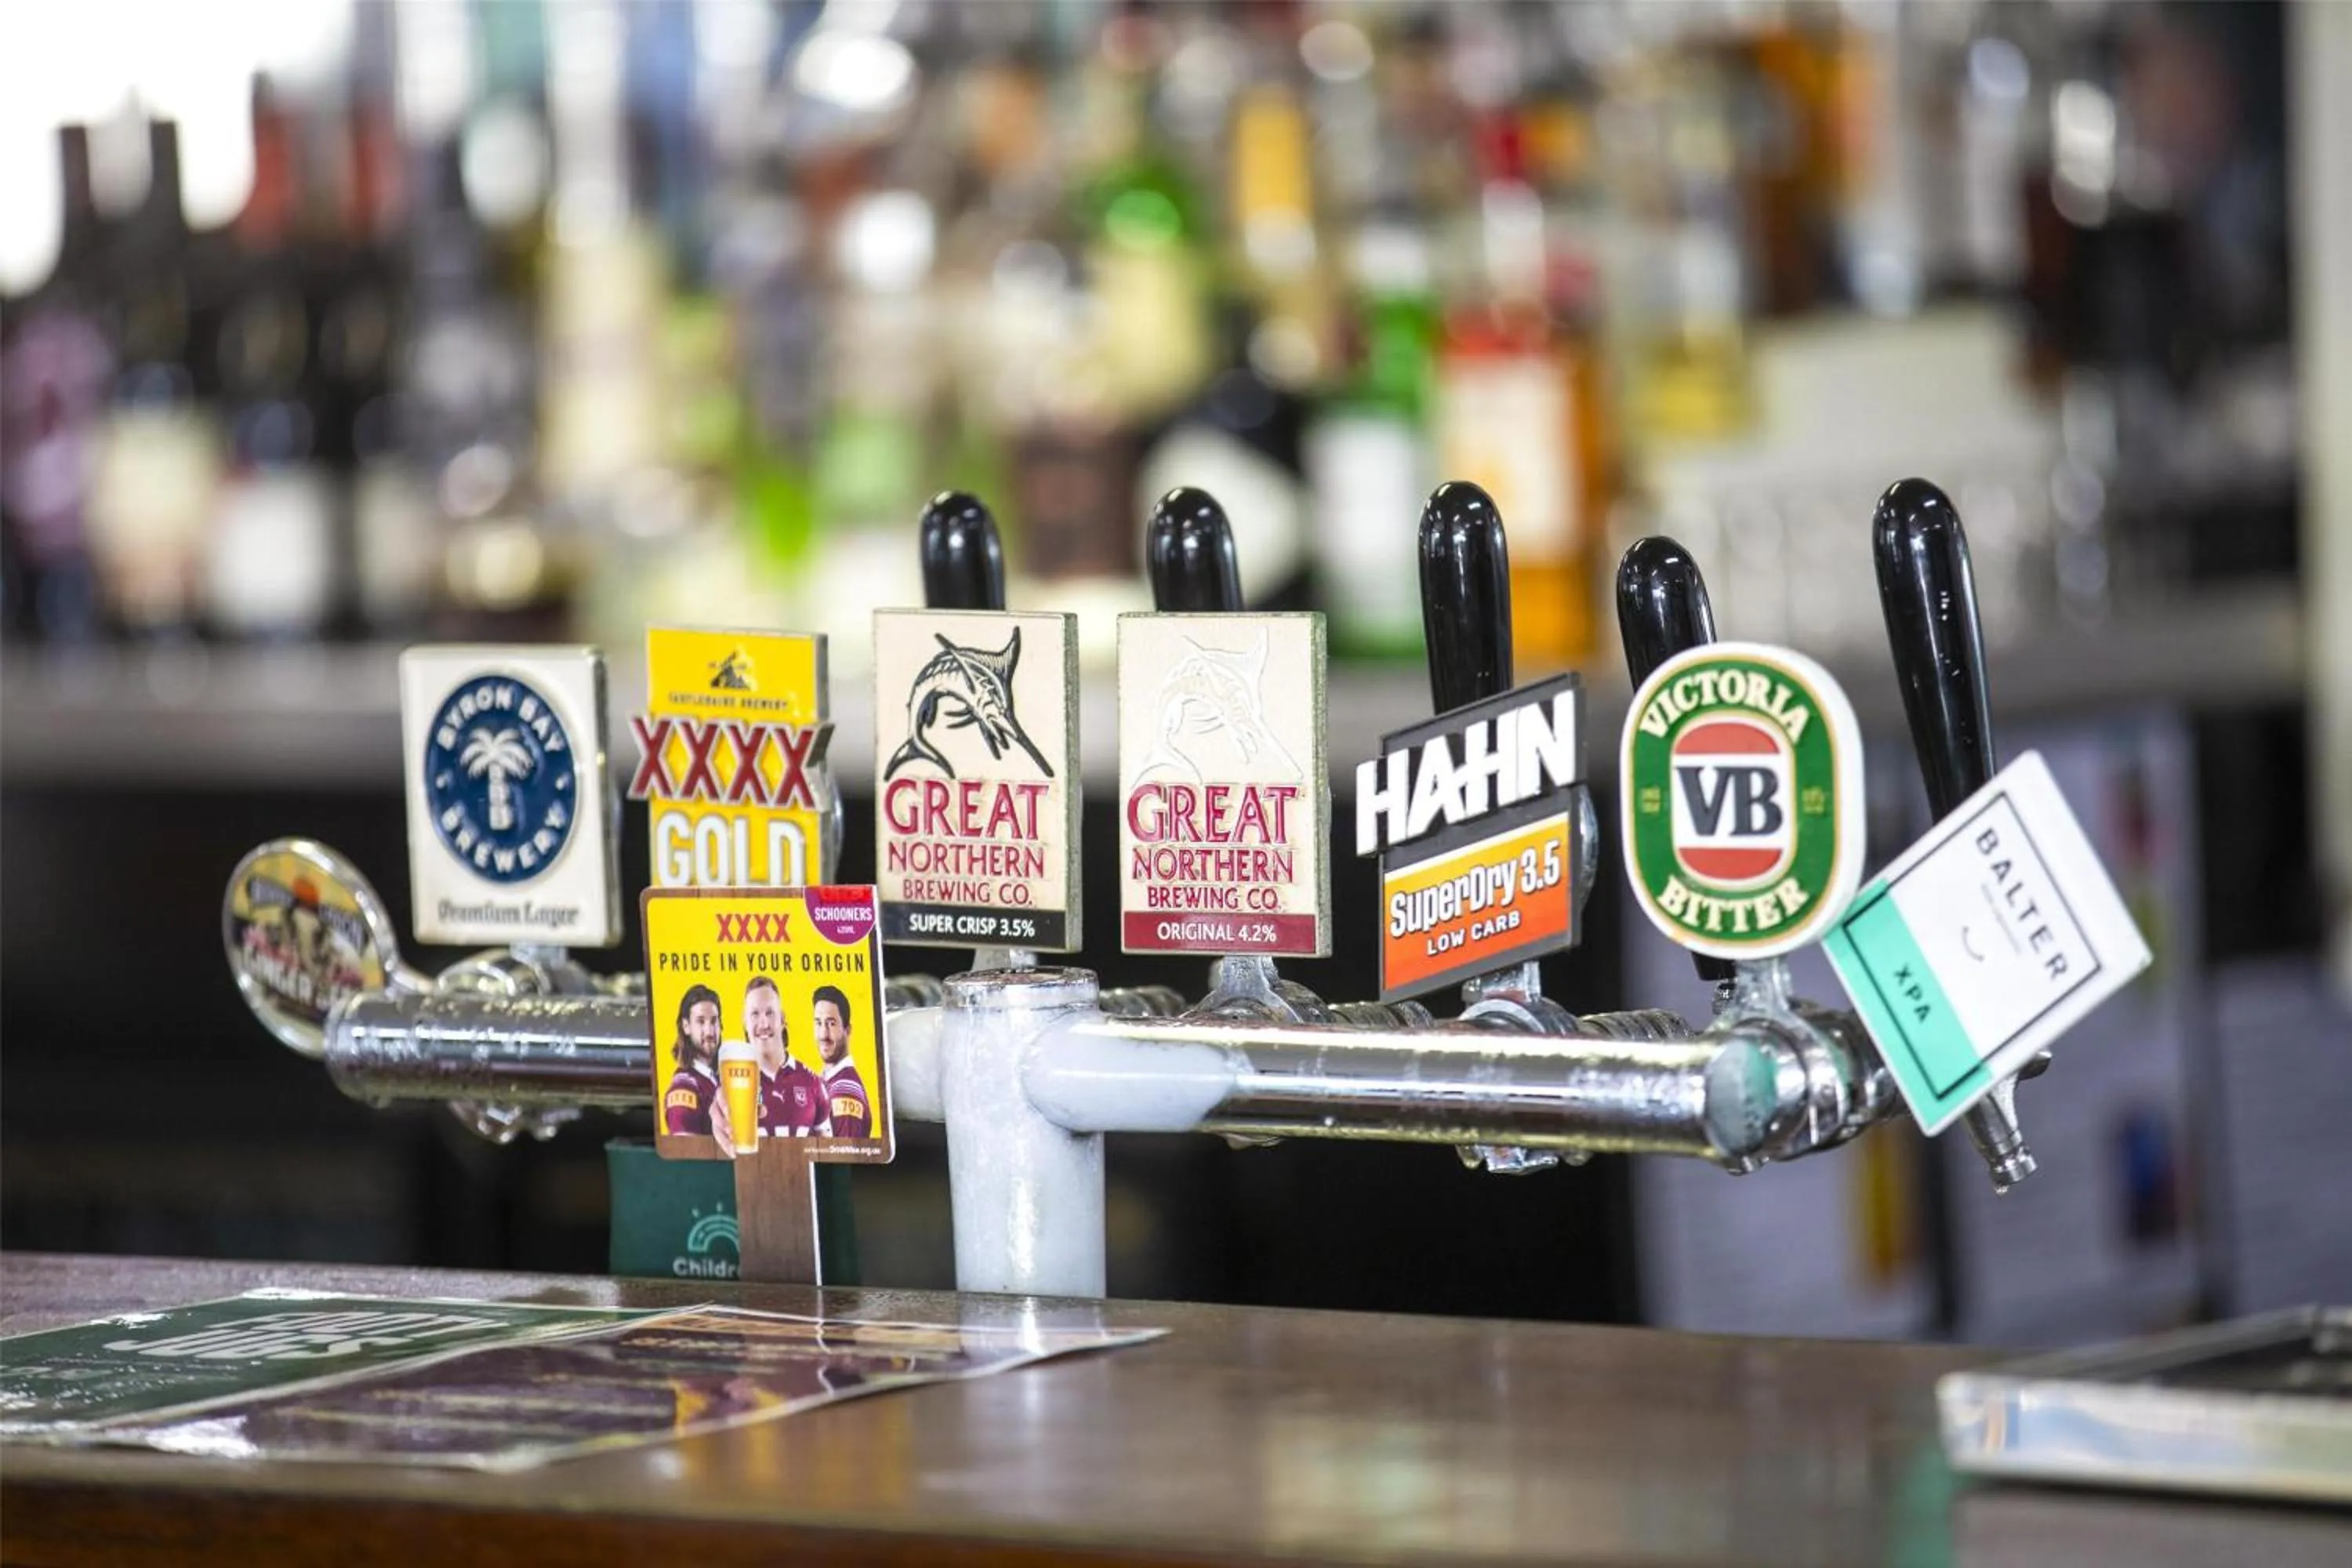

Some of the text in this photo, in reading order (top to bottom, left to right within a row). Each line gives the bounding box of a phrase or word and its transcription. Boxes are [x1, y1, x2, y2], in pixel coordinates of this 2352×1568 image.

[436, 686, 566, 752] BYRON BAY
[1639, 669, 1809, 745] VICTORIA
[629, 717, 818, 810] XXXX
[1356, 689, 1575, 857] HAHN
[884, 779, 1049, 840] GREAT
[1127, 783, 1298, 844] GREAT
[1676, 765, 1783, 837] VB
[441, 800, 567, 874] BREWERY
[657, 812, 806, 887] GOLD
[887, 841, 1044, 879] NORTHERN
[1131, 848, 1294, 884] NORTHERN
[814, 906, 873, 922] SCHOONERS
[903, 879, 1033, 906] BREWING CO.
[1147, 887, 1239, 909] BREWING
[1390, 840, 1561, 938] SuperDry 3.5
[1657, 875, 1809, 933] BITTER
[1974, 827, 2068, 980] BALTER
[716, 913, 792, 942] XXXX
[909, 913, 1035, 937] SUPER CRISP 3.5%
[1157, 922, 1277, 942] ORIGINAL 4.2%
[1427, 910, 1520, 956] LOW CARB
[659, 953, 865, 973] PRIDE IN YOUR ORIGIN
[1893, 964, 1932, 1025] XPA
[102, 1329, 414, 1360] JUGS
[205, 1312, 511, 1338] FOOTY
